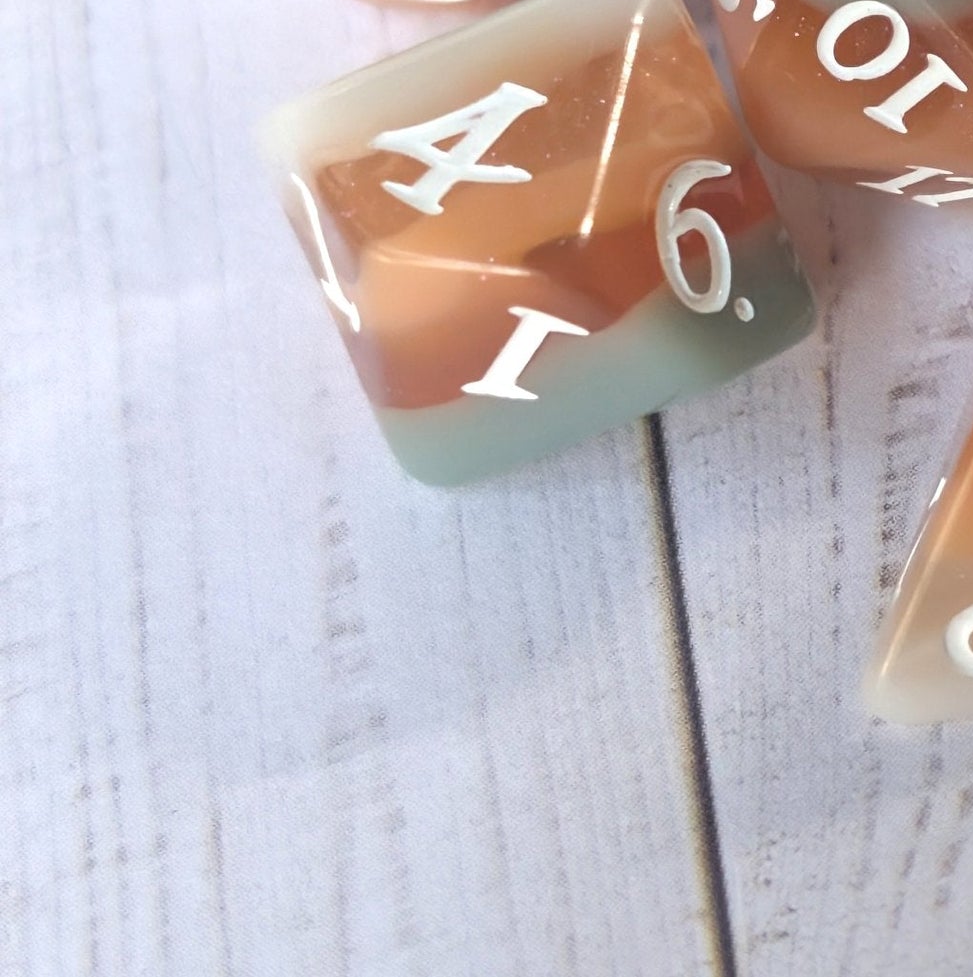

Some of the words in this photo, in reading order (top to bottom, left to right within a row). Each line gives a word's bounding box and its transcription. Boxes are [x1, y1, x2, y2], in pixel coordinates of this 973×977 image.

[816, 0, 968, 134] 10
[368, 81, 549, 216] 4
[460, 306, 591, 401] 1
